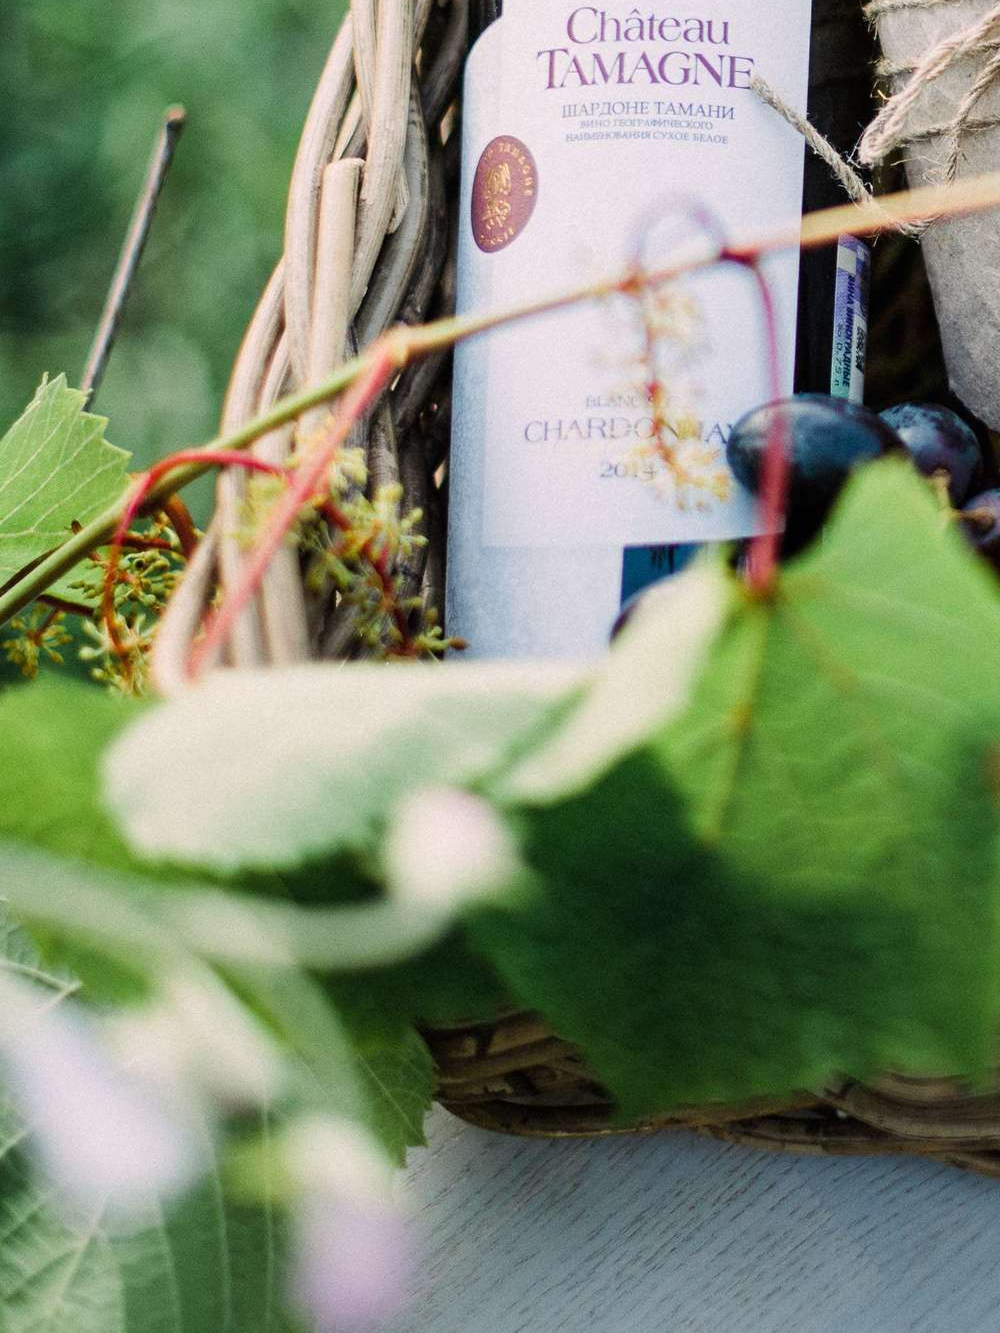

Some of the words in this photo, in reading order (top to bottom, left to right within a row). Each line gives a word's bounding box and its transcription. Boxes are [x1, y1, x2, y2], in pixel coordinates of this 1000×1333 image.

[566, 6, 730, 45] Château
[535, 48, 755, 90] TAMAGNE
[561, 100, 650, 118] ШАРДОНЕ
[653, 100, 736, 120] ТАМАНИ
[523, 416, 735, 444] CHARDONA
